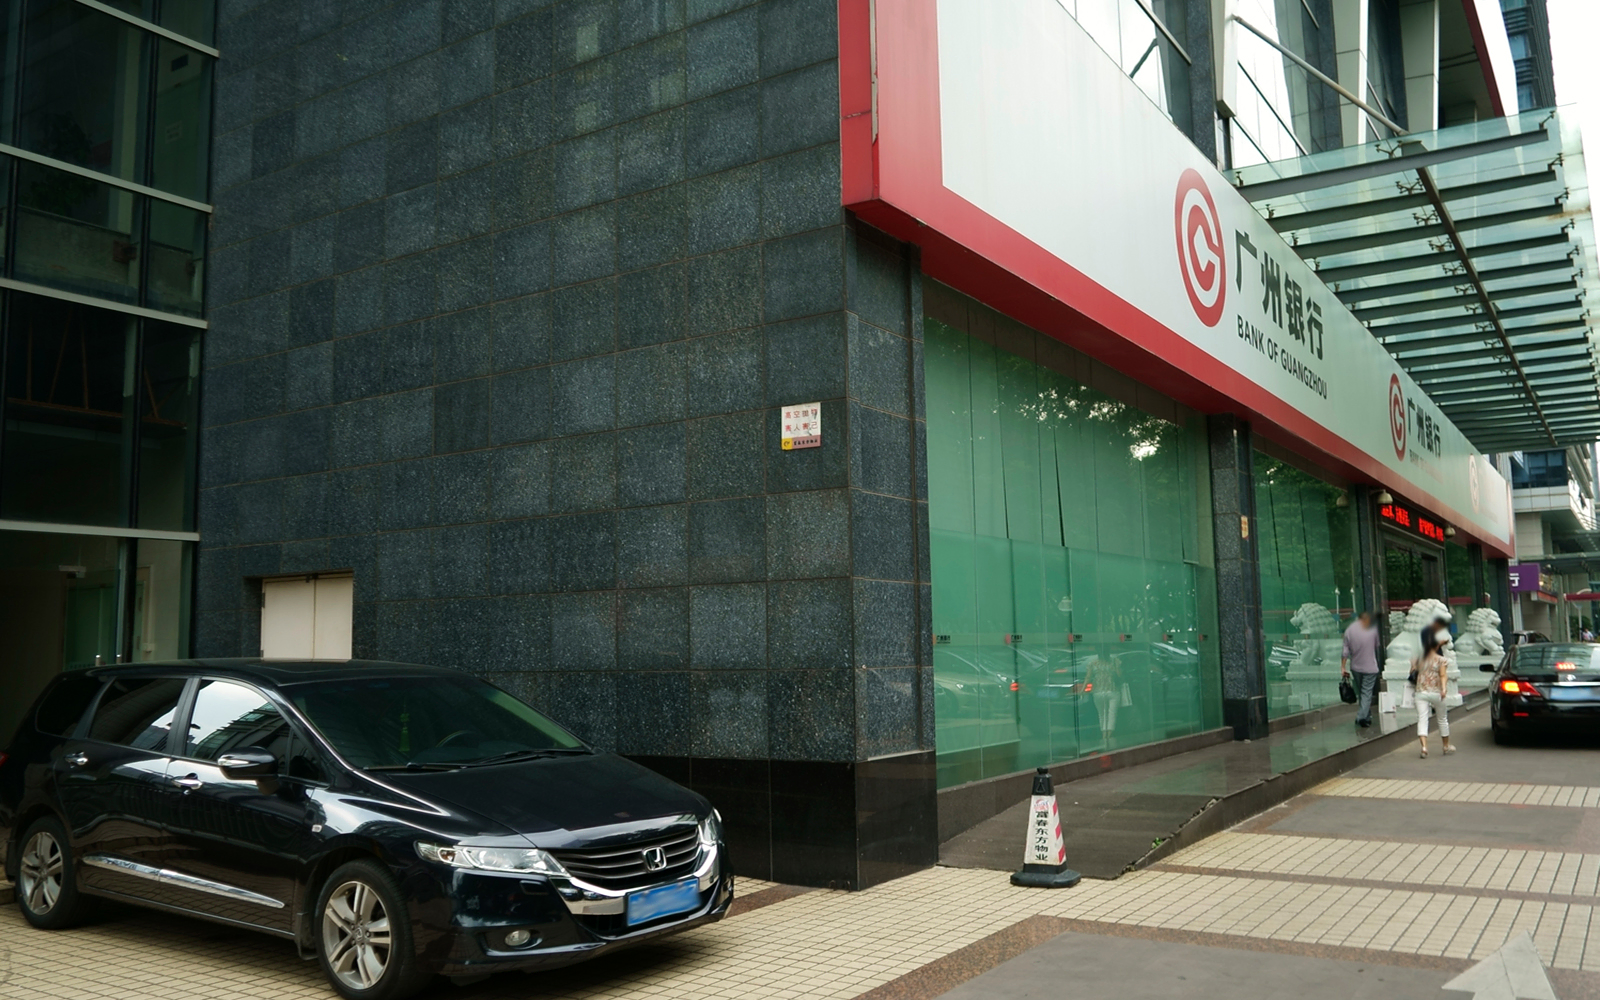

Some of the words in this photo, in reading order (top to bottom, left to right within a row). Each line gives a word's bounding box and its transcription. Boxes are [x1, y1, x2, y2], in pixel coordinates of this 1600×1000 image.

[1235, 228, 1324, 361] 广州银行
[1237, 314, 1265, 354] BANK
[1267, 337, 1279, 364] OF
[1280, 348, 1328, 400] GUANGZHOU
[1407, 397, 1441, 458] 广州银行
[1034, 810, 1049, 861] 富春东方物业
